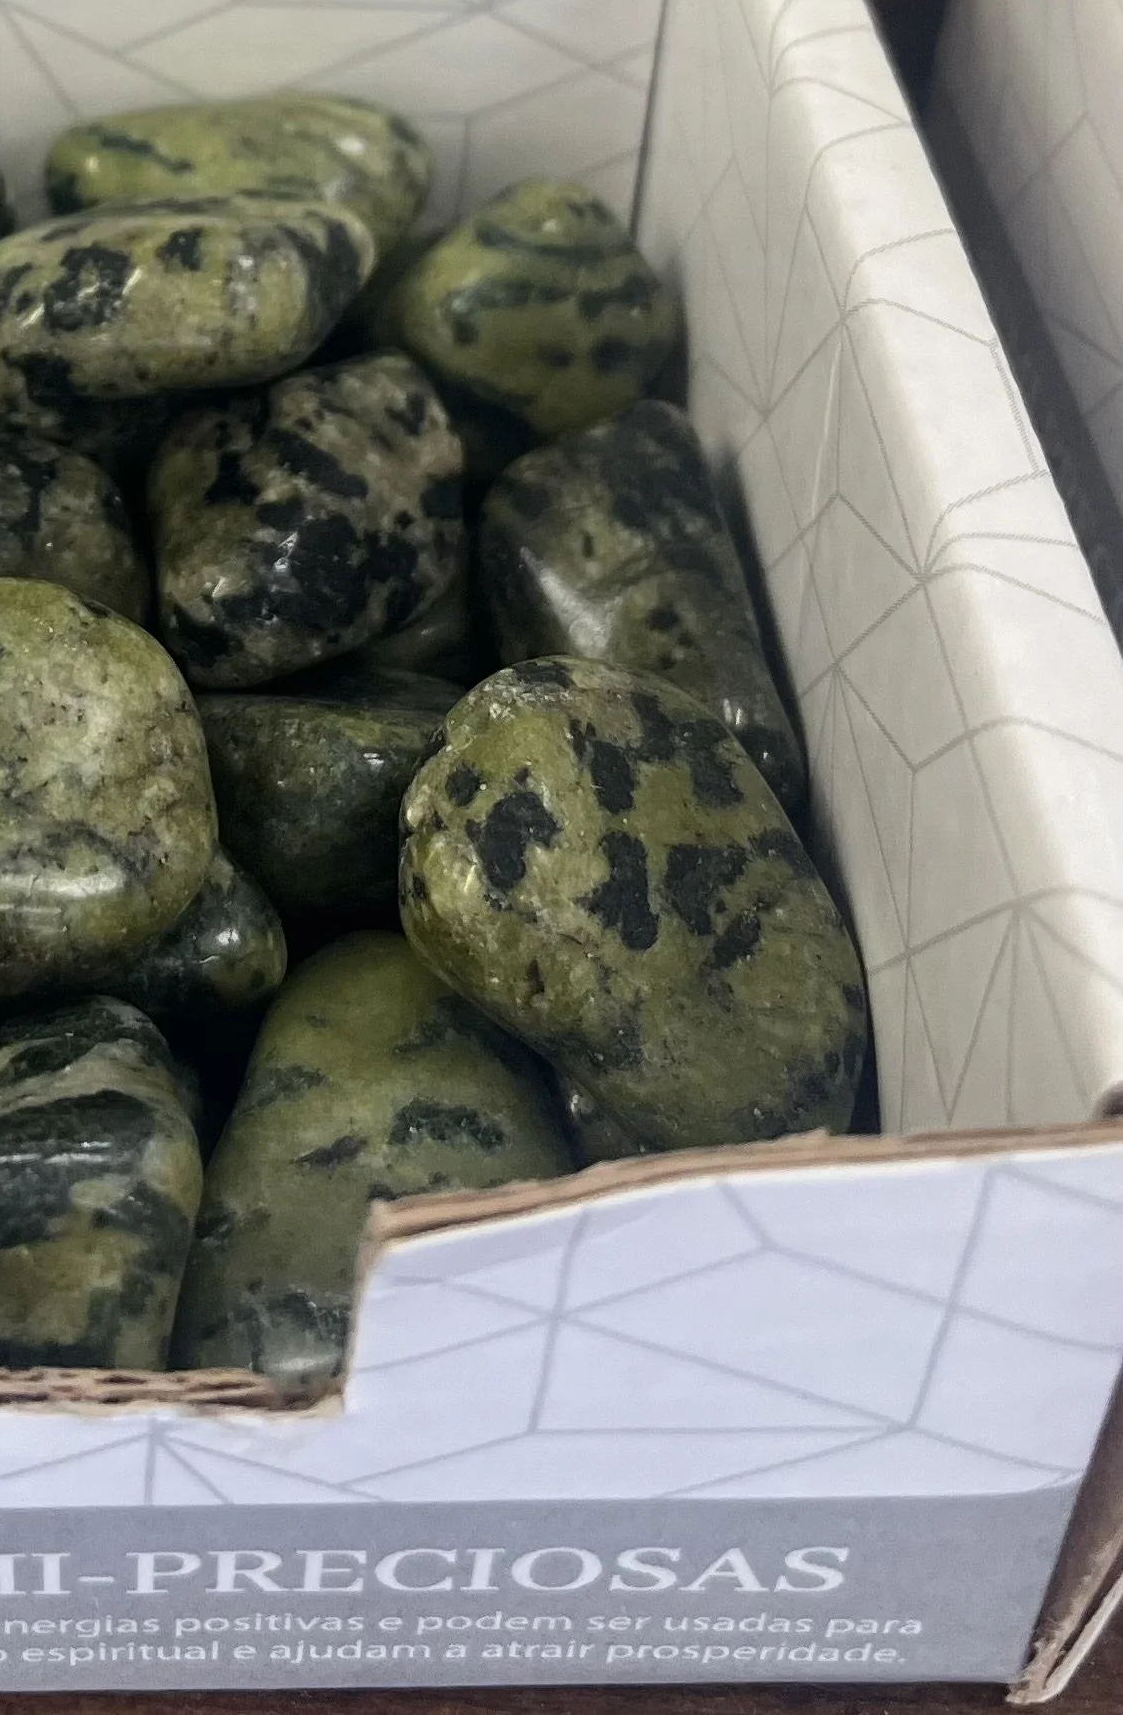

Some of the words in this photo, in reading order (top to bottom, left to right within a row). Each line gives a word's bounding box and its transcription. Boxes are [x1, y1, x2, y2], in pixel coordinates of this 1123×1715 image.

[174, 1612, 365, 1639] positivas
[377, 1616, 404, 1632] e
[414, 1610, 573, 1636] podem
[586, 1615, 652, 1632] ser
[663, 1612, 814, 1634] usadas
[824, 1618, 924, 1639] para
[20, 1640, 219, 1666] espiritual
[232, 1643, 258, 1660] e
[268, 1639, 431, 1664] ajudam
[442, 1642, 467, 1660] a
[480, 1640, 595, 1660] atrair
[605, 1641, 908, 1663] prosperidade.
